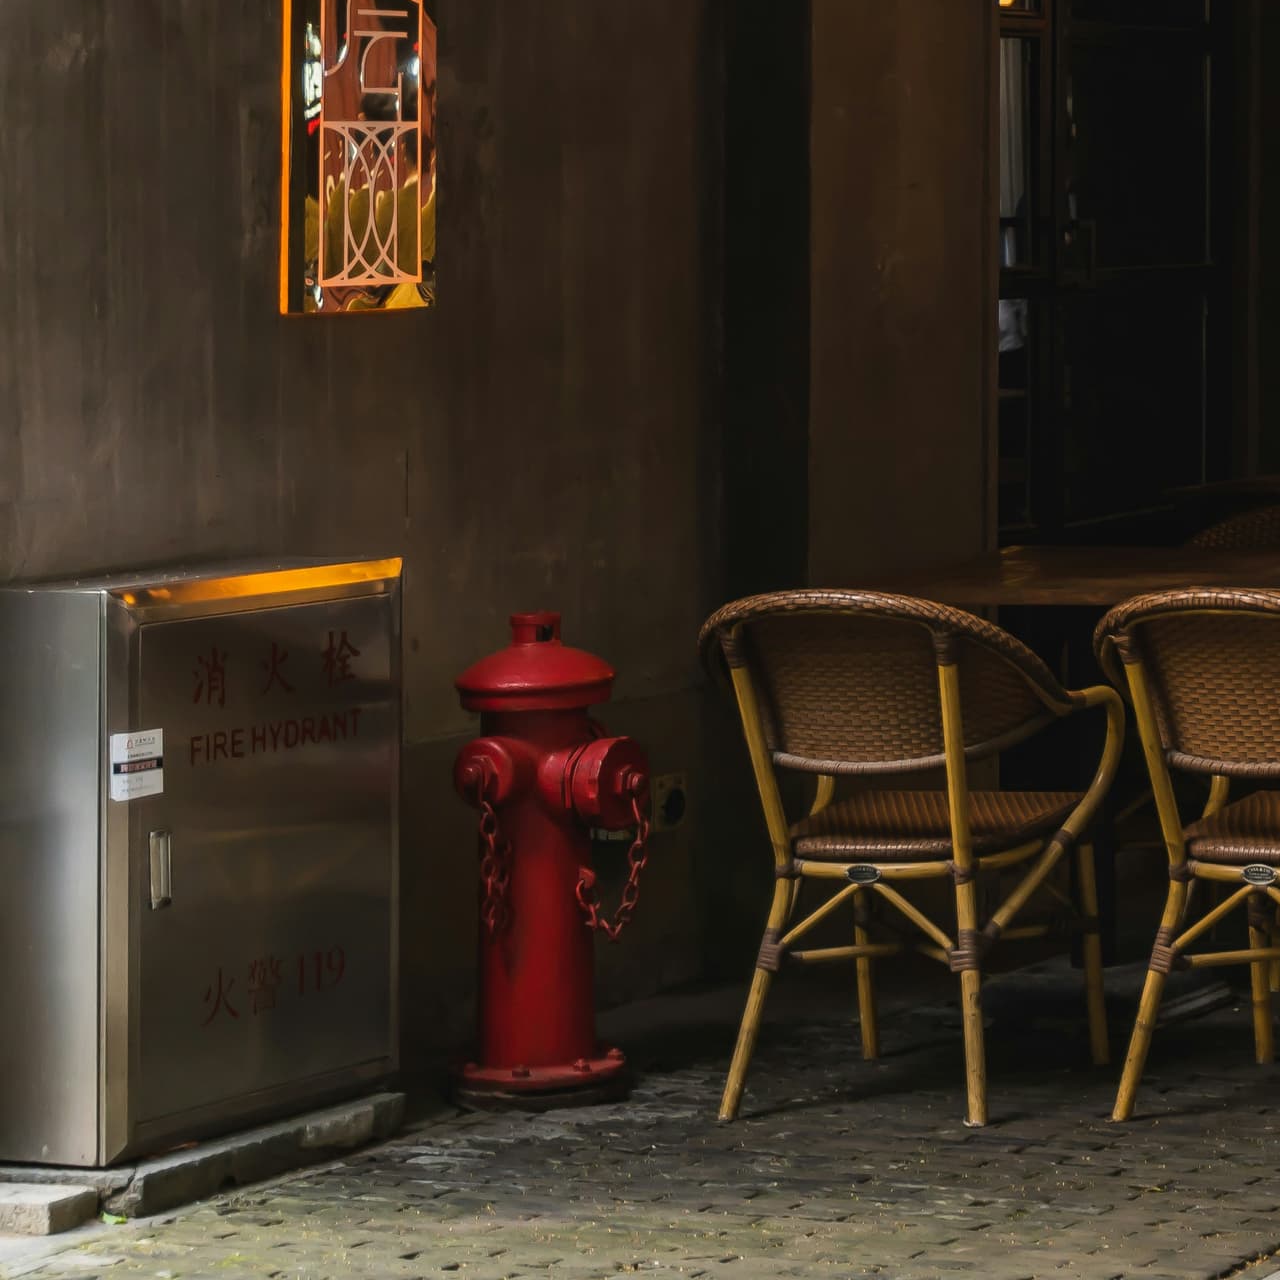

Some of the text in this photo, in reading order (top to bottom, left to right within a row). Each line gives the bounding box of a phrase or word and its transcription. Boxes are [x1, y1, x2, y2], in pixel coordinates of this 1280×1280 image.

[192, 631, 361, 708] 消火栓
[190, 708, 362, 767] FIRE HYDRANT
